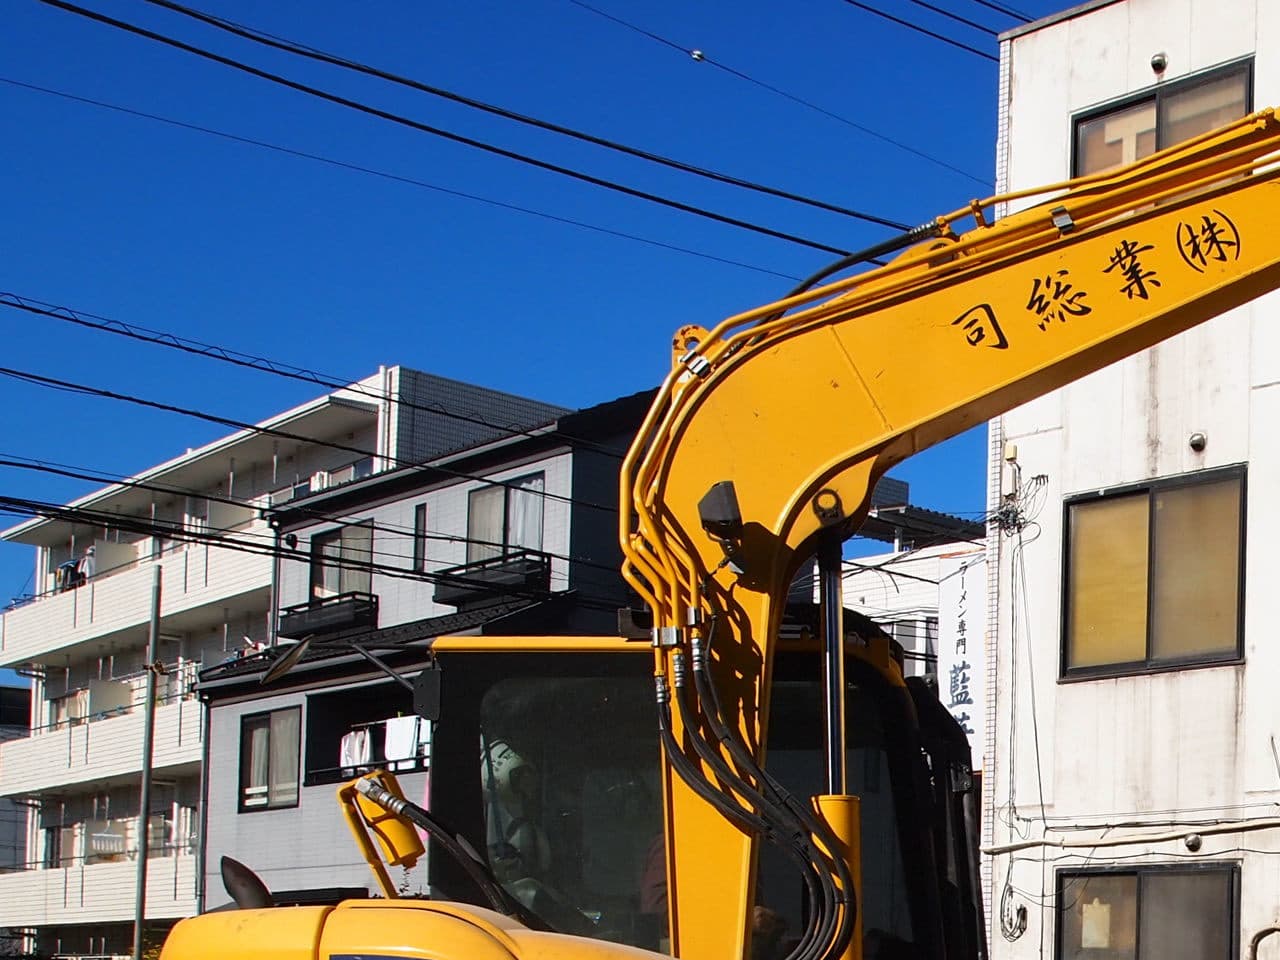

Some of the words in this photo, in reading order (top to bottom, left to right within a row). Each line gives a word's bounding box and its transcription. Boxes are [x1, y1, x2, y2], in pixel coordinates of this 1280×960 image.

[956, 561, 968, 655] ラーメン専門
